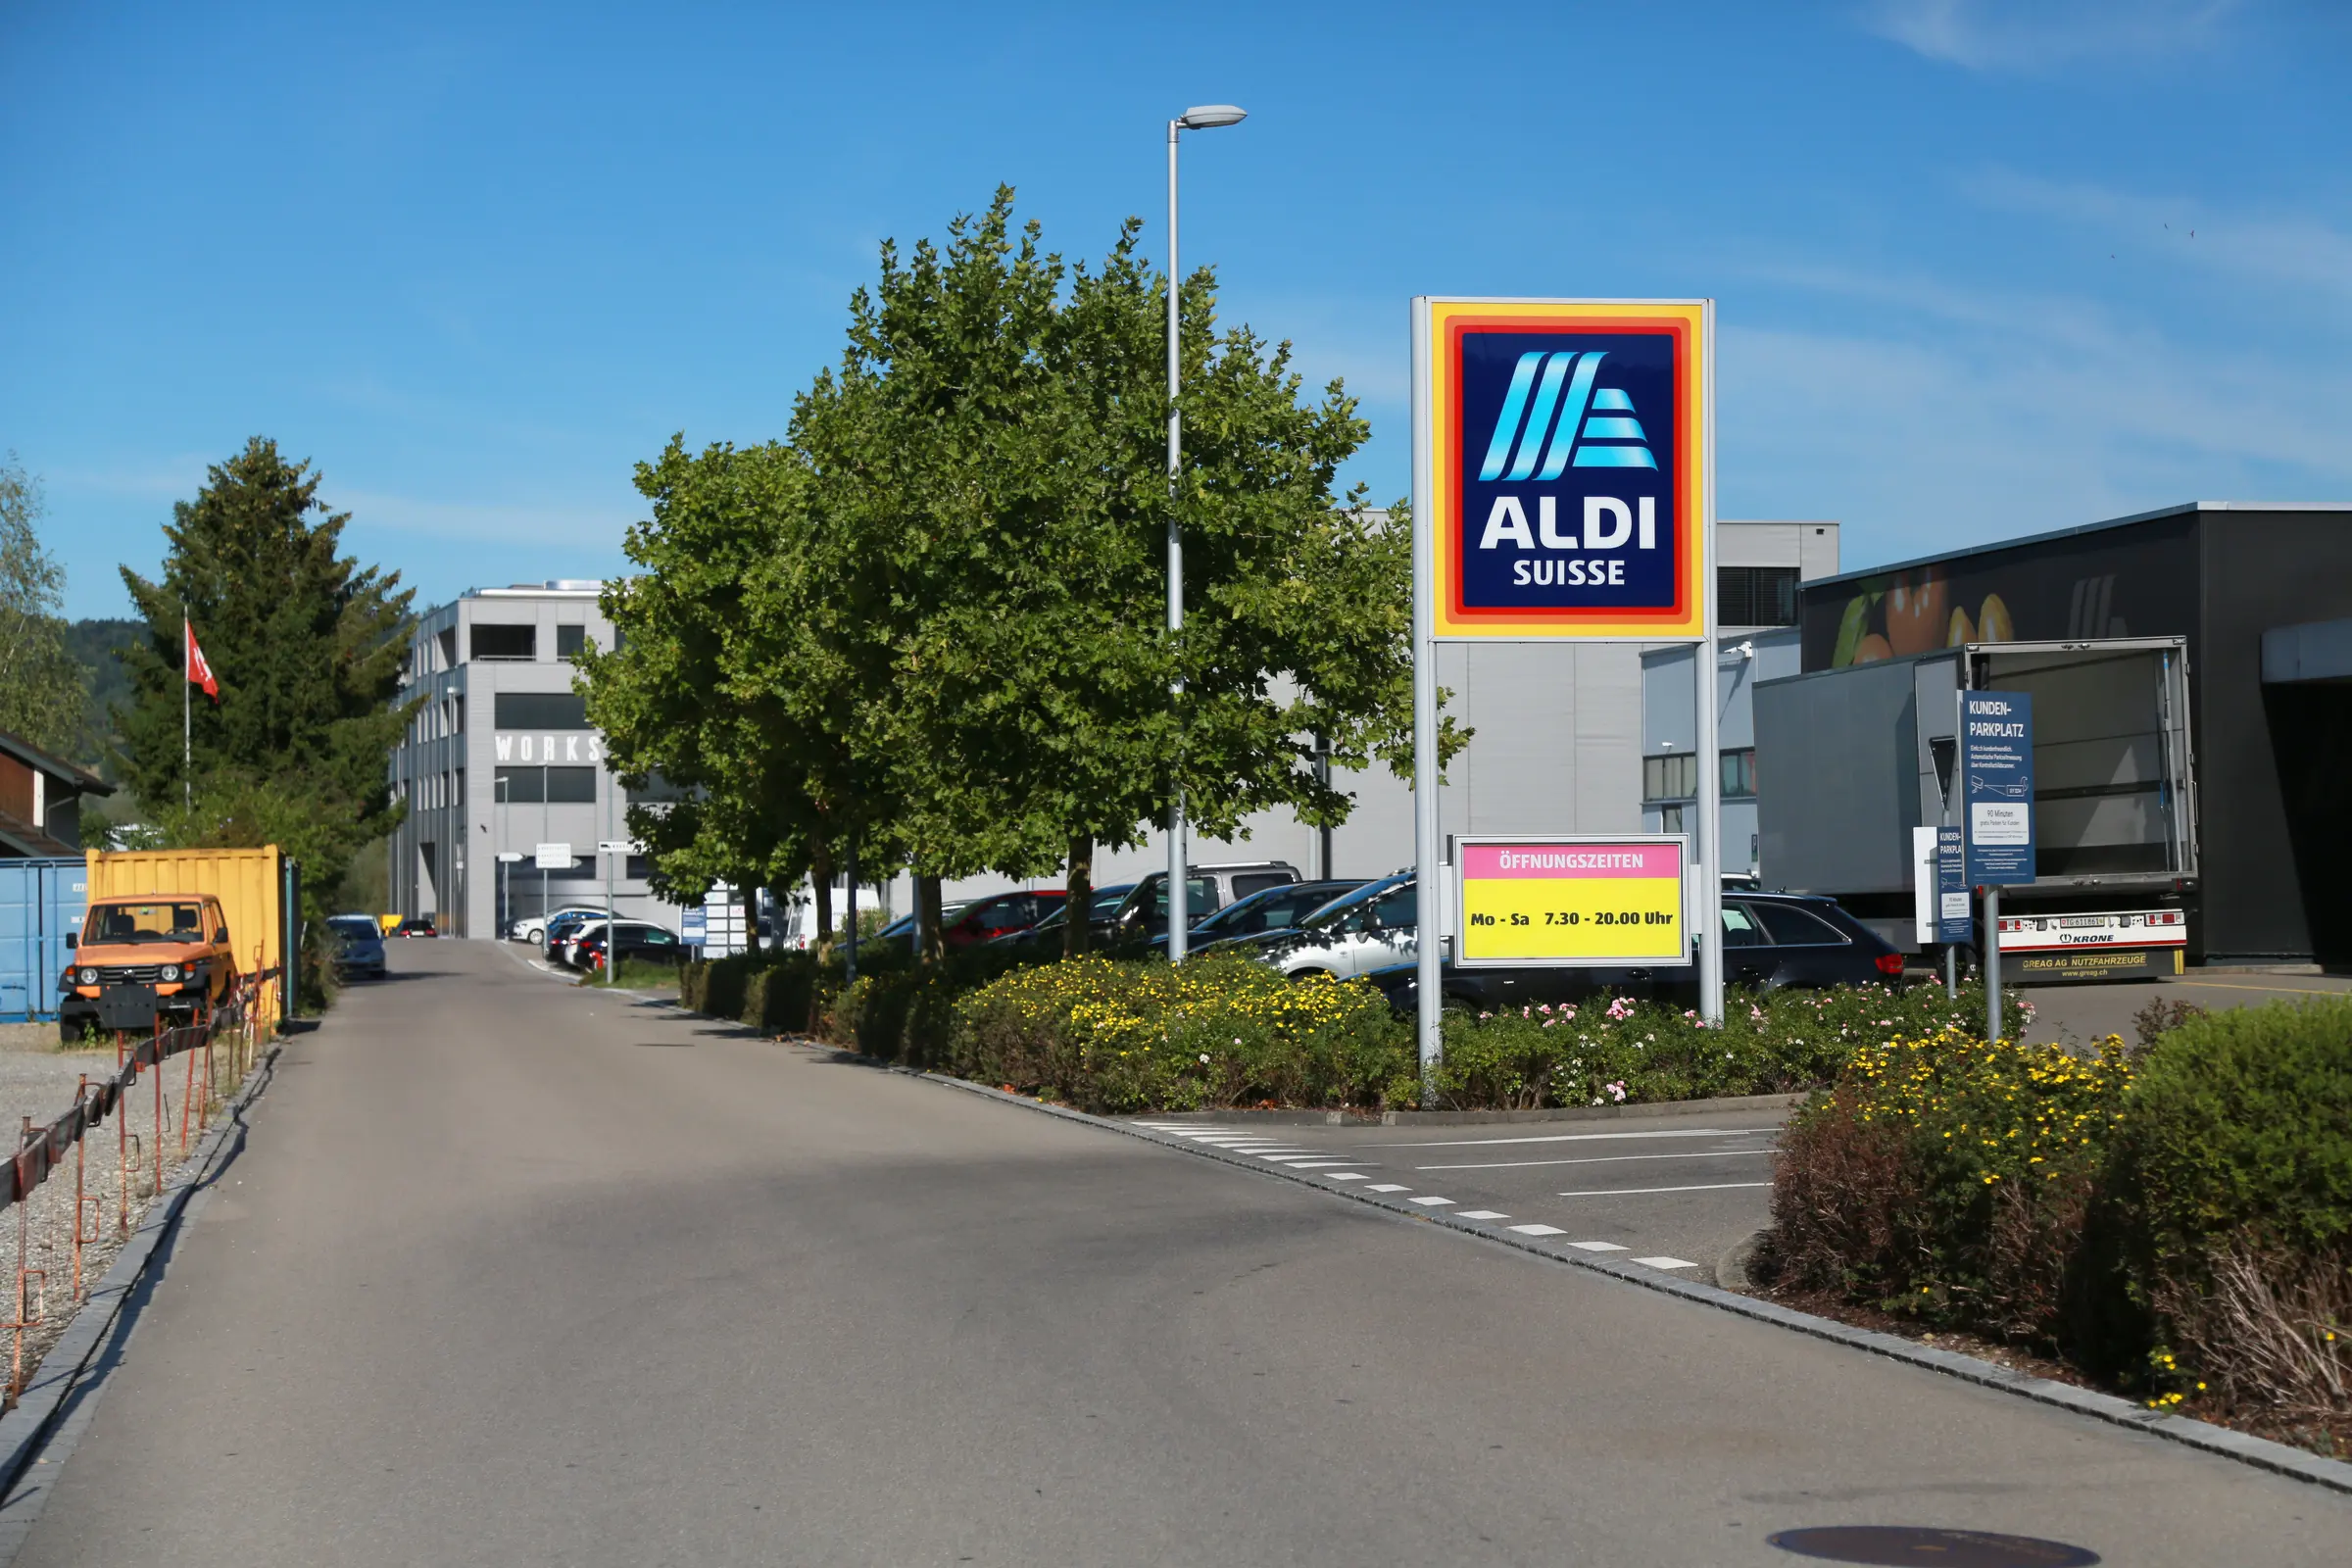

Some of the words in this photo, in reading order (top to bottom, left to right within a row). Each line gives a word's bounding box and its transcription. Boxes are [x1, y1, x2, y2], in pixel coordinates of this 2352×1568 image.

[1479, 495, 1656, 550] ALDI
[1513, 560, 1626, 586] SUISSE
[1970, 700, 2012, 715] KUNDEN-
[1970, 721, 2025, 738] PARKPLATZ
[495, 735, 601, 761] WORKS
[1939, 845, 1962, 855] PARKPLA
[1499, 850, 1643, 869] ÖFFNUNGSZEITEN
[1470, 913, 1495, 926] Mo
[1510, 912, 1530, 926] Sa
[1544, 912, 1580, 925] 7.30
[1594, 911, 1641, 925] 20.00
[1644, 910, 1674, 925] Uhr
[2073, 934, 2114, 943] KRONE
[2023, 958, 2053, 968] GREAG
[2054, 958, 2068, 967] AG
[2071, 955, 2147, 966] NUTZFAHRZEUGE
[2061, 968, 2108, 978] www.greag.ch
